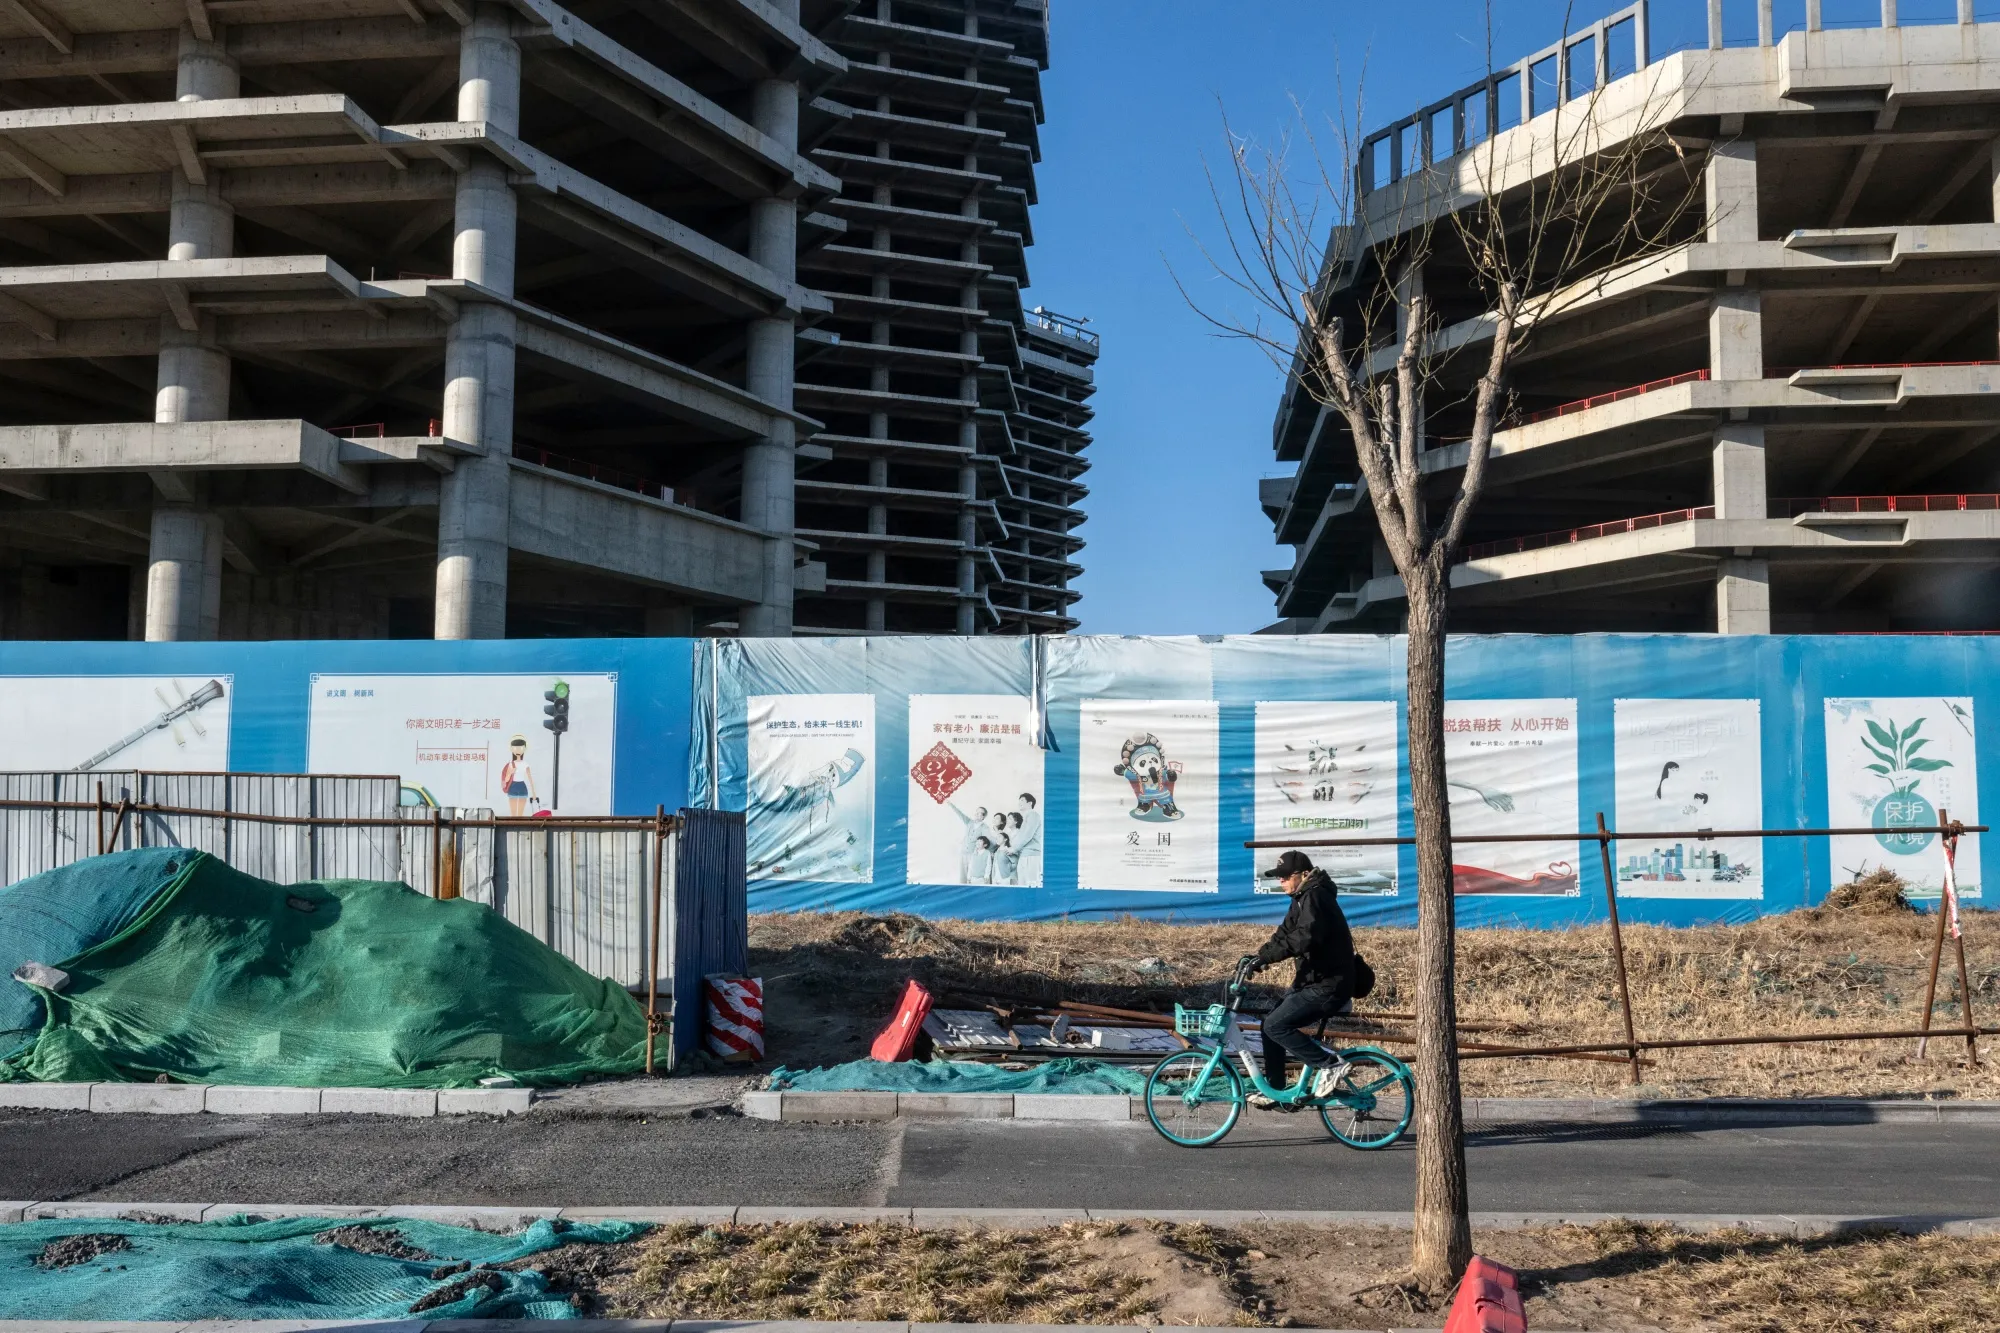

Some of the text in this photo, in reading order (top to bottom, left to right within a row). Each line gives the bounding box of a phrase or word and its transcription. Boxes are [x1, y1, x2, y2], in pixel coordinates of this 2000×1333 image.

[405, 718, 501, 729] 你离文明只差一步之遥
[933, 723, 1021, 735] 家有老小 廉洁是福
[1444, 717, 1569, 732] 脱贫帮扶 从心开始
[418, 752, 487, 761] 机动车要礼让斑马线
[1884, 801, 1923, 825] 保护
